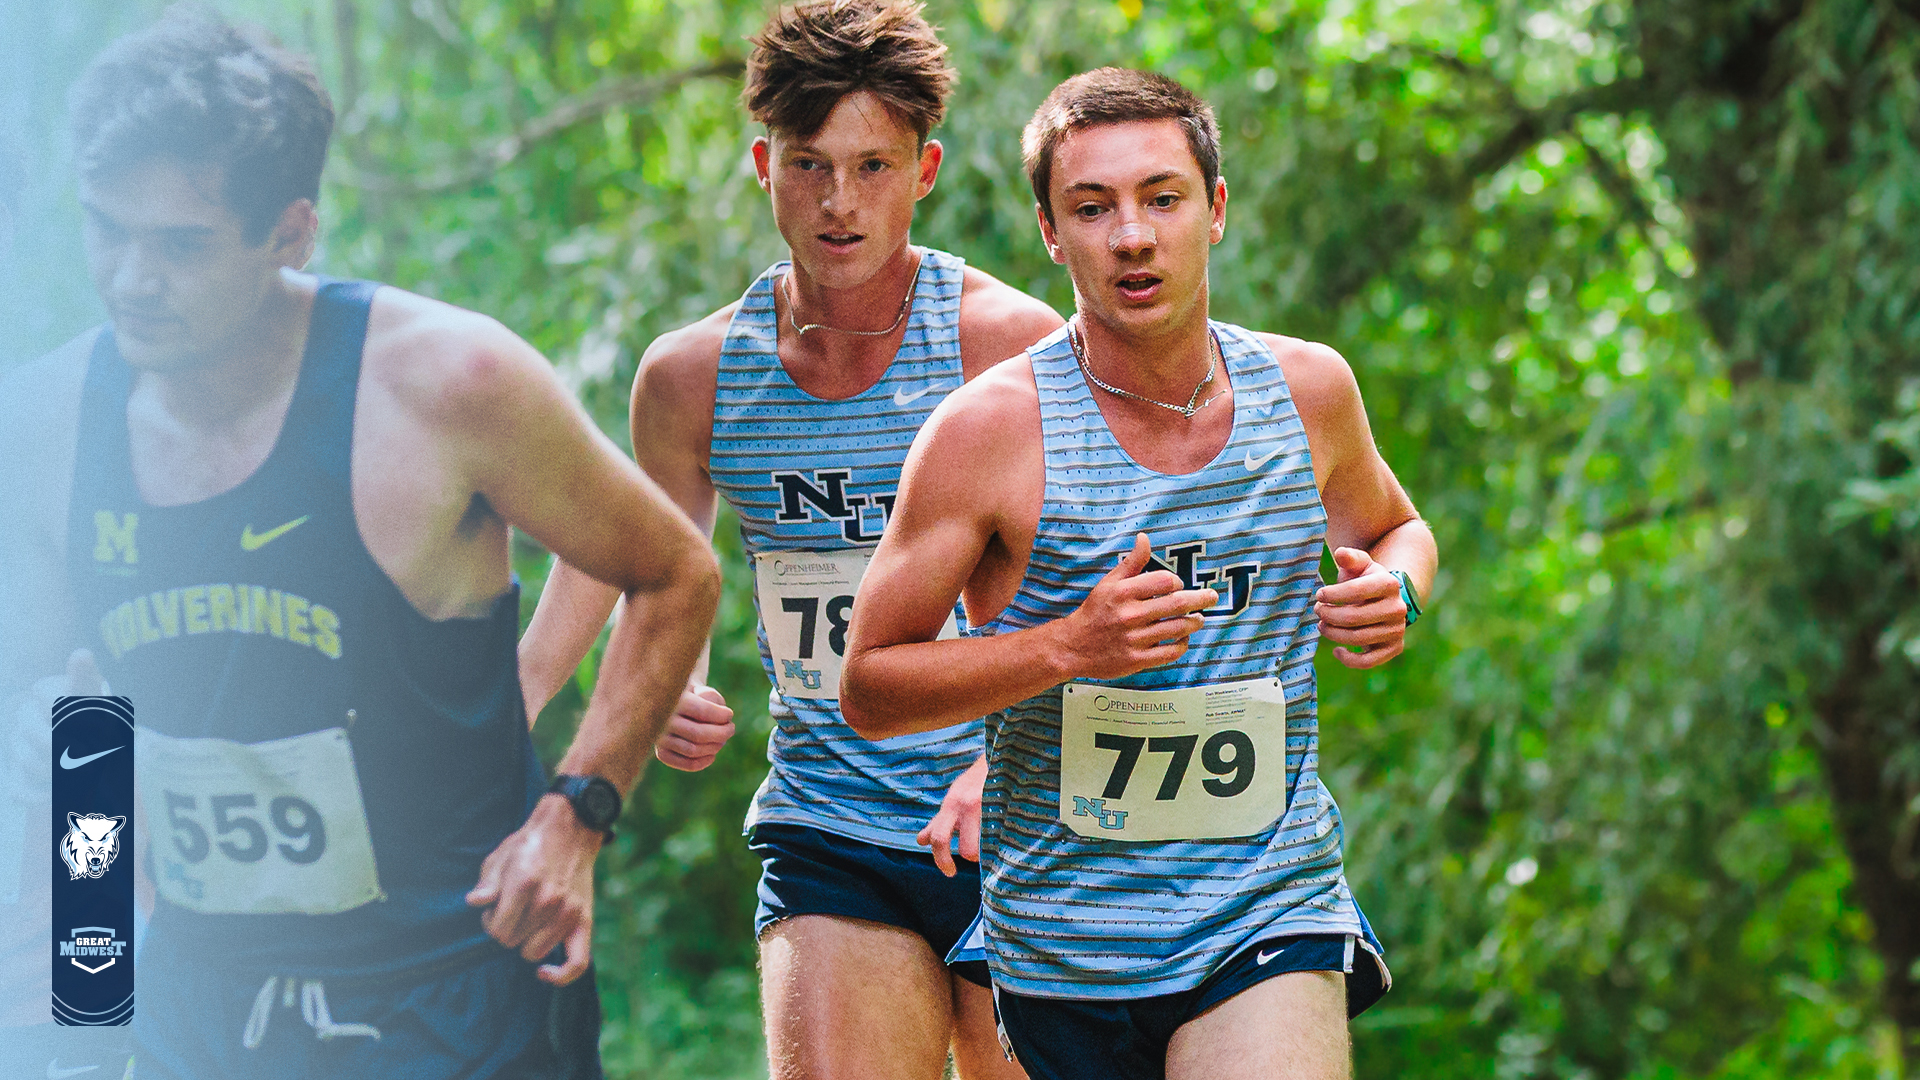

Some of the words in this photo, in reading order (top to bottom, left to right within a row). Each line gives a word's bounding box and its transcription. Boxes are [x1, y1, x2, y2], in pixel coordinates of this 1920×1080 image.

[771, 468, 898, 545] NU
[94, 510, 138, 563] M
[774, 560, 840, 576] OPPENHEIMER
[782, 659, 822, 690] NU
[1094, 695, 1178, 713] OPPENHEIMER
[1095, 729, 1256, 801] 779
[163, 789, 327, 868] 559
[1073, 796, 1128, 830] NU
